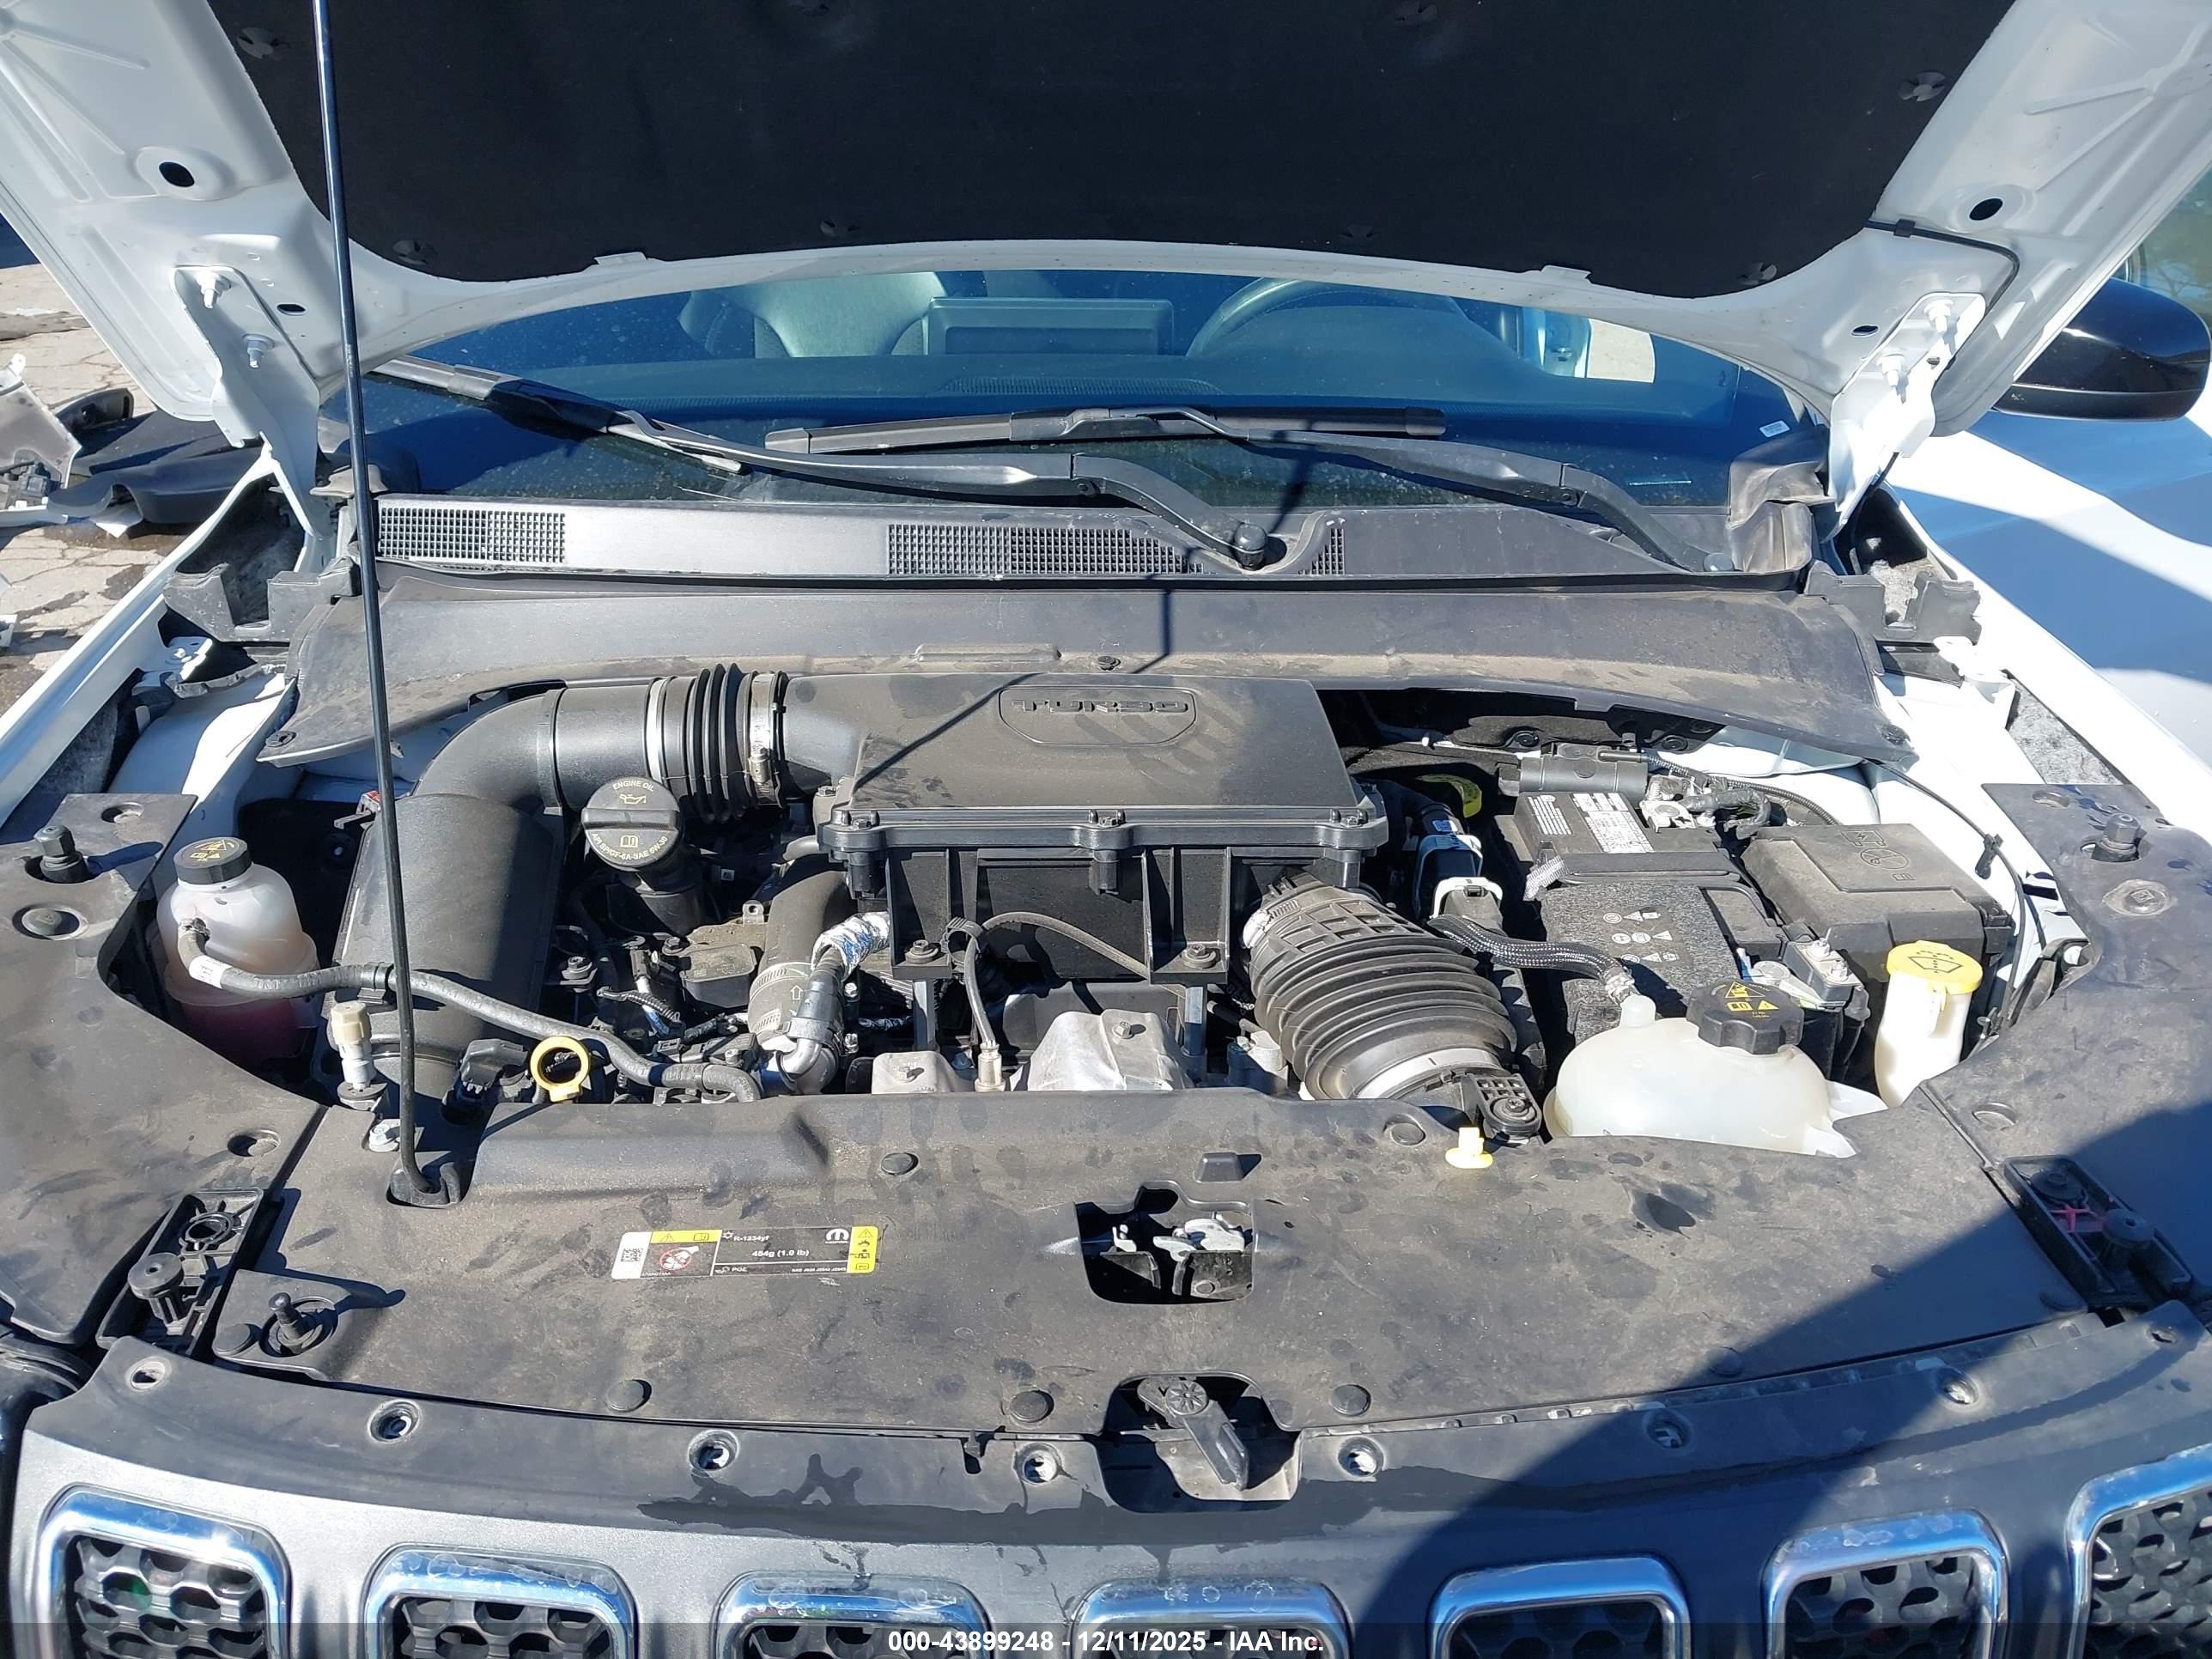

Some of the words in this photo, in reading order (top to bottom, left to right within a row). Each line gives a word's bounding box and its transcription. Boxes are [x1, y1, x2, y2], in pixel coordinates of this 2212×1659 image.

[1012, 699, 1189, 714] TURBO
[612, 781, 642, 790] ENGINE
[642, 782, 654, 792] OIL
[592, 833, 603, 844] API
